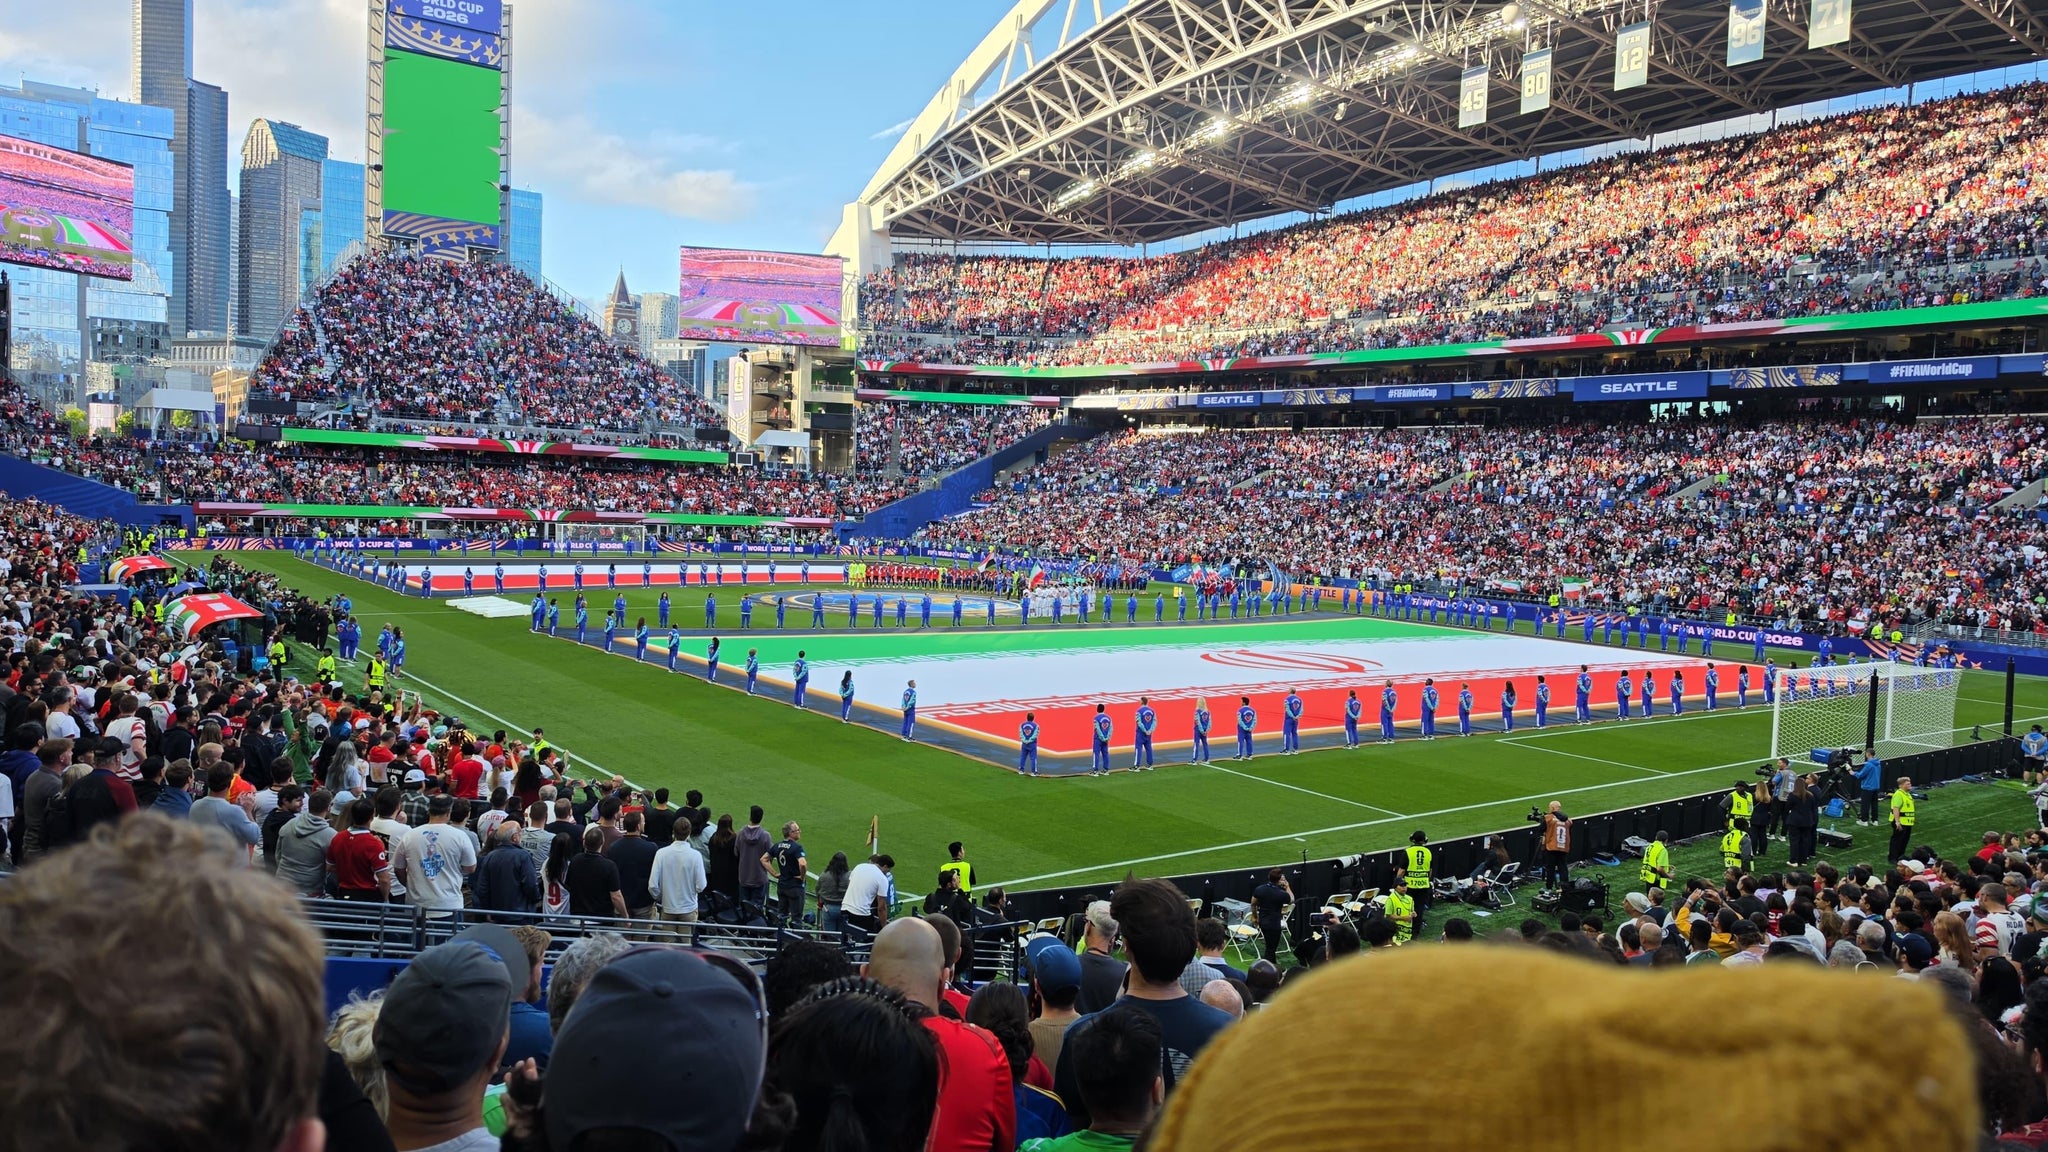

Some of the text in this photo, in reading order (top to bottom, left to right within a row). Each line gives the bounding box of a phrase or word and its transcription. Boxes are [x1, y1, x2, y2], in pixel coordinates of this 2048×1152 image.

[422, 6, 469, 24] 2026
[458, 2, 484, 15] CUP
[1731, 20, 1762, 48] 96
[1621, 46, 1644, 73] 12
[1524, 72, 1547, 98] 80
[1462, 88, 1484, 112] 45
[1890, 362, 1973, 377] #FIFAWorldCup
[1388, 388, 1438, 399] #FIFAWorldCup
[1600, 381, 1678, 394] SEATTLE
[1203, 395, 1254, 405] SEATTLE
[1304, 586, 1337, 598] SETTLE
[1696, 624, 1736, 639] WRLD
[1765, 633, 1803, 646] 2026
[779, 849, 786, 866] 6
[548, 882, 561, 906] 9
